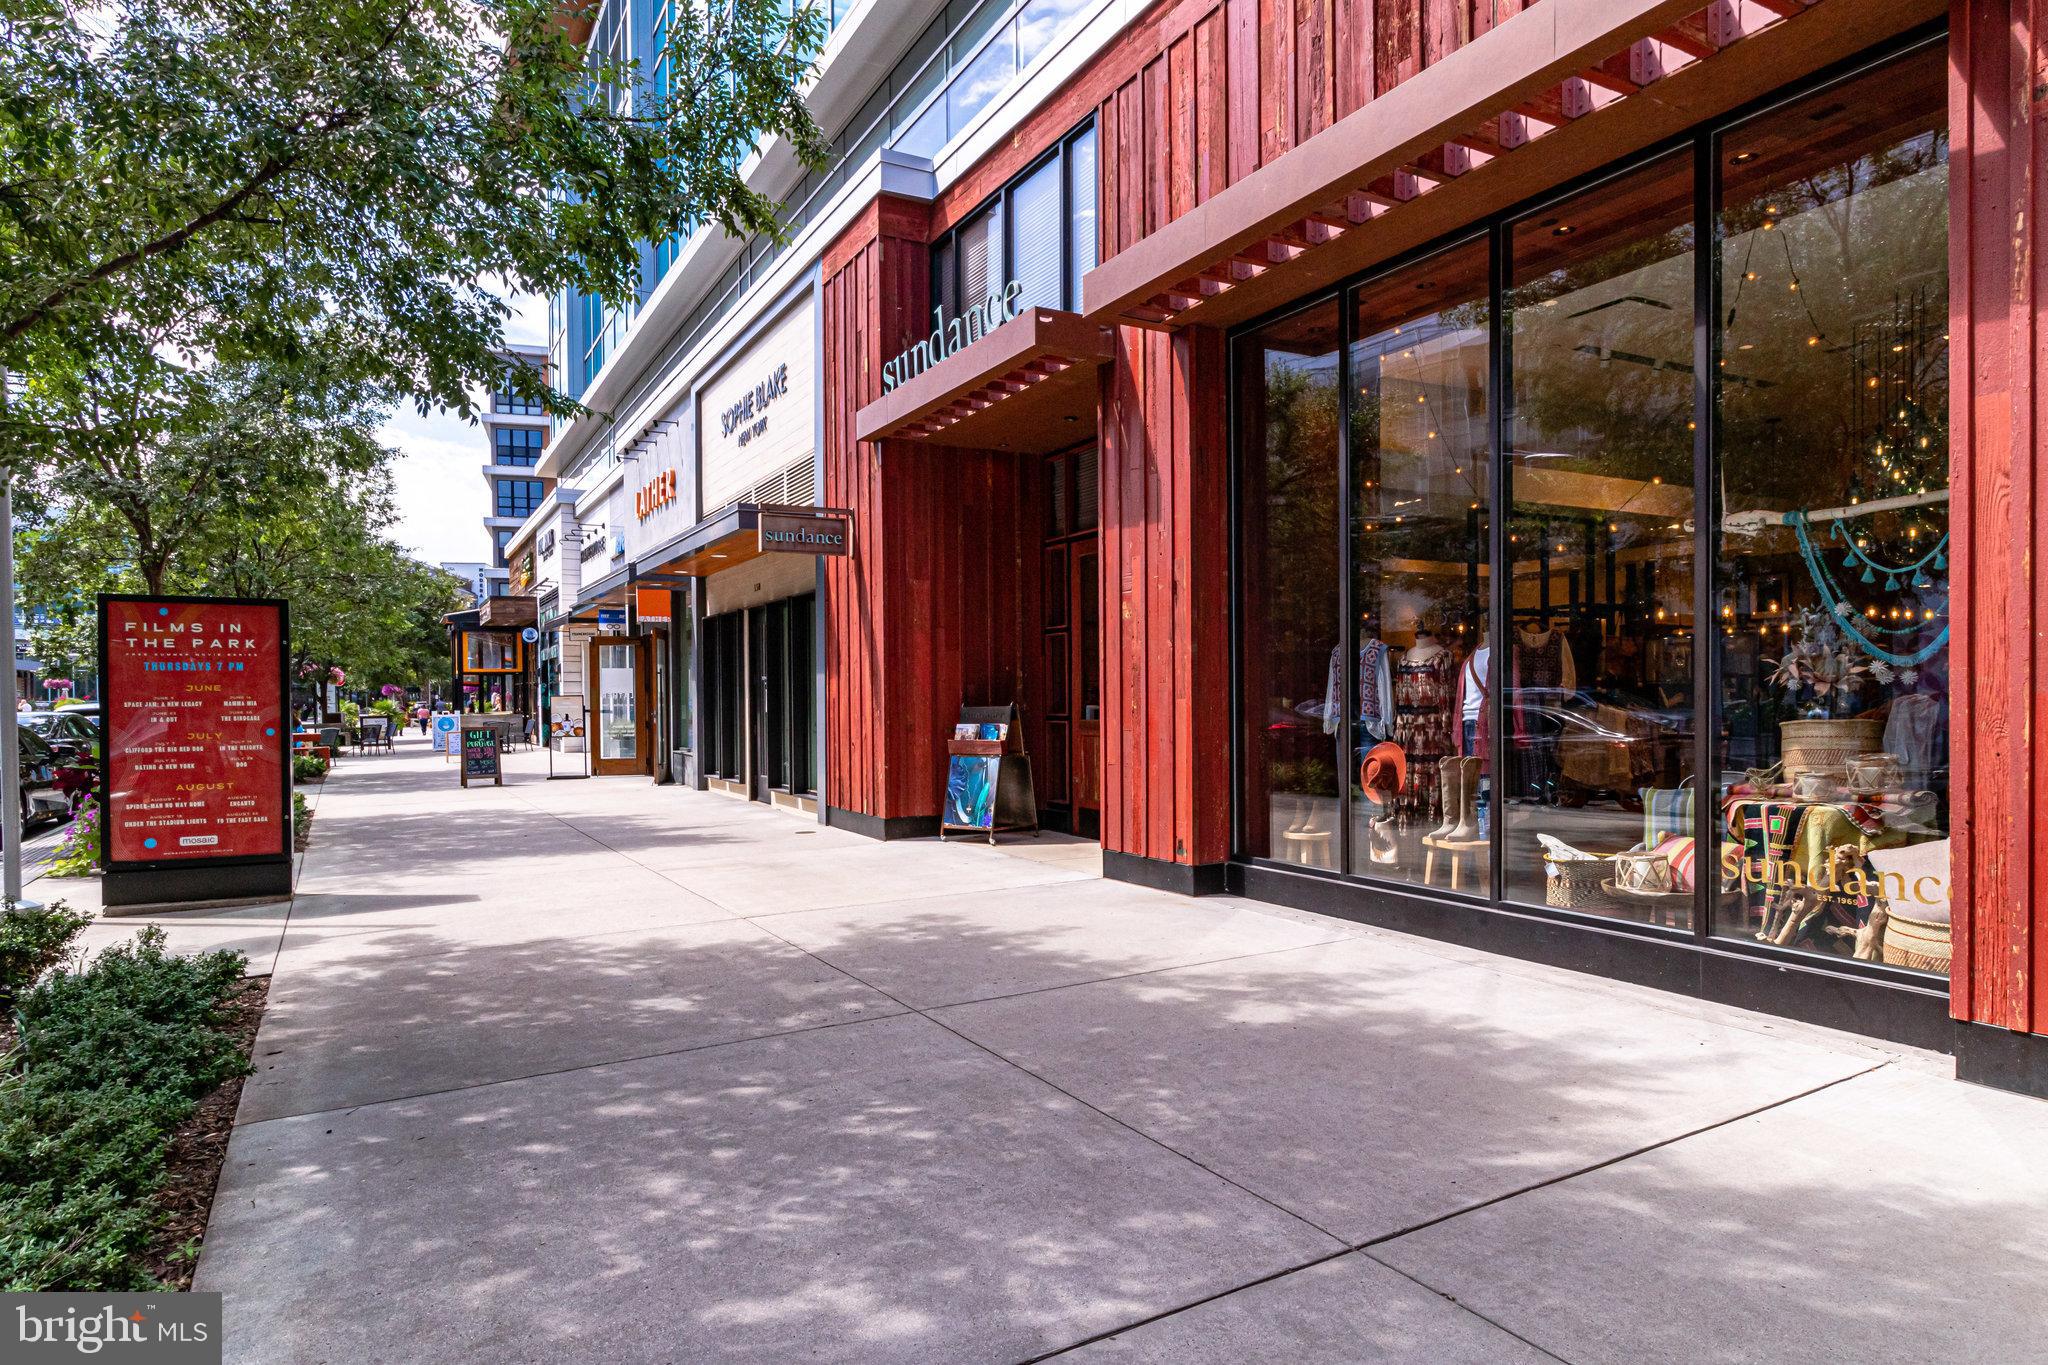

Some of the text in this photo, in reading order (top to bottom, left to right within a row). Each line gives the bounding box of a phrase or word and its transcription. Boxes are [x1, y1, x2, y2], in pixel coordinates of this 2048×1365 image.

[882, 280, 1023, 396] sundance
[721, 362, 788, 438] SOPHIE BLAKE
[738, 415, 769, 447] NEW YORK
[635, 467, 677, 520] LATHER
[765, 527, 842, 545] sundance
[125, 622, 241, 633] FILMS IN
[126, 638, 256, 648] THE PARK
[144, 661, 244, 671] THURSDAYS 7 PM
[186, 684, 221, 692] JUNE
[187, 732, 224, 741] JULY
[469, 730, 491, 739] GIFT
[176, 782, 235, 791] AUGUST
[182, 837, 216, 845] mosaic
[1721, 849, 1951, 905] sundanc
[1816, 894, 1858, 906] EST. 1969
